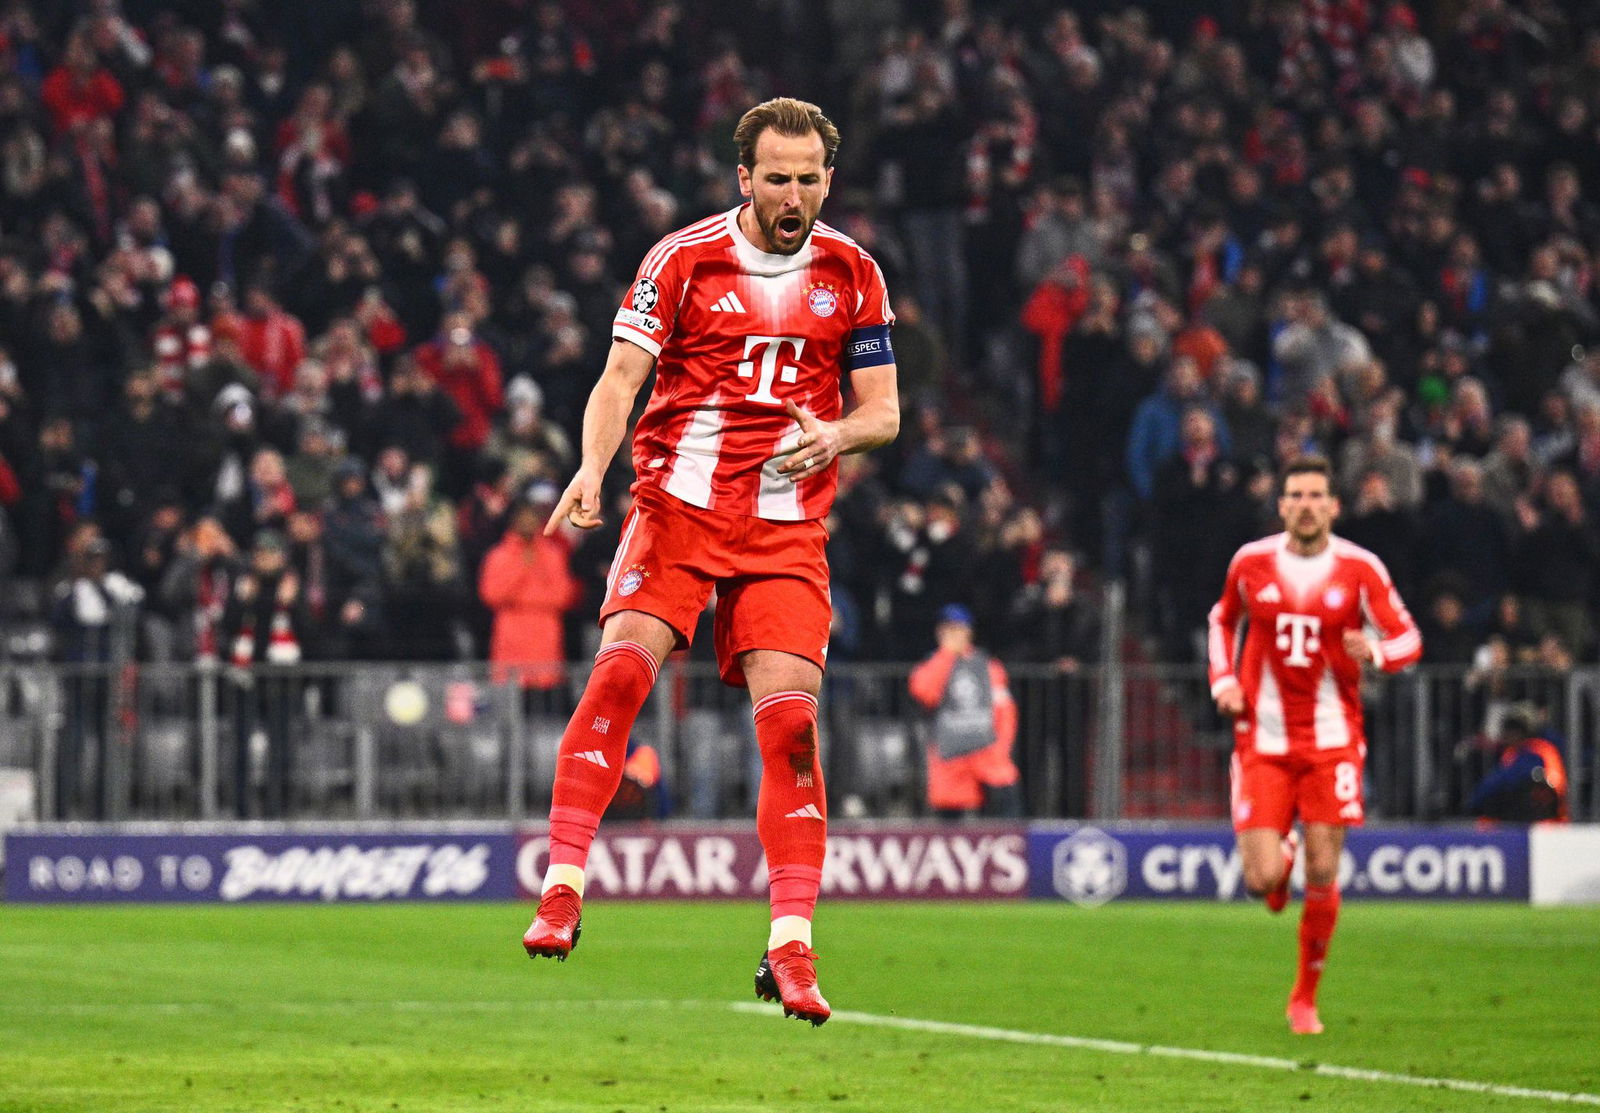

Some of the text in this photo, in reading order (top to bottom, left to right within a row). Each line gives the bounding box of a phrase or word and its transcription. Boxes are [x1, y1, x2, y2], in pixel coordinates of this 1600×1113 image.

[738, 335, 806, 404] T
[1276, 612, 1321, 668] T
[1334, 761, 1358, 801] 8
[28, 855, 144, 892] ROAD
[155, 855, 213, 892] TO
[750, 835, 1028, 896] RWAYS
[1142, 843, 1505, 900] cry.com
